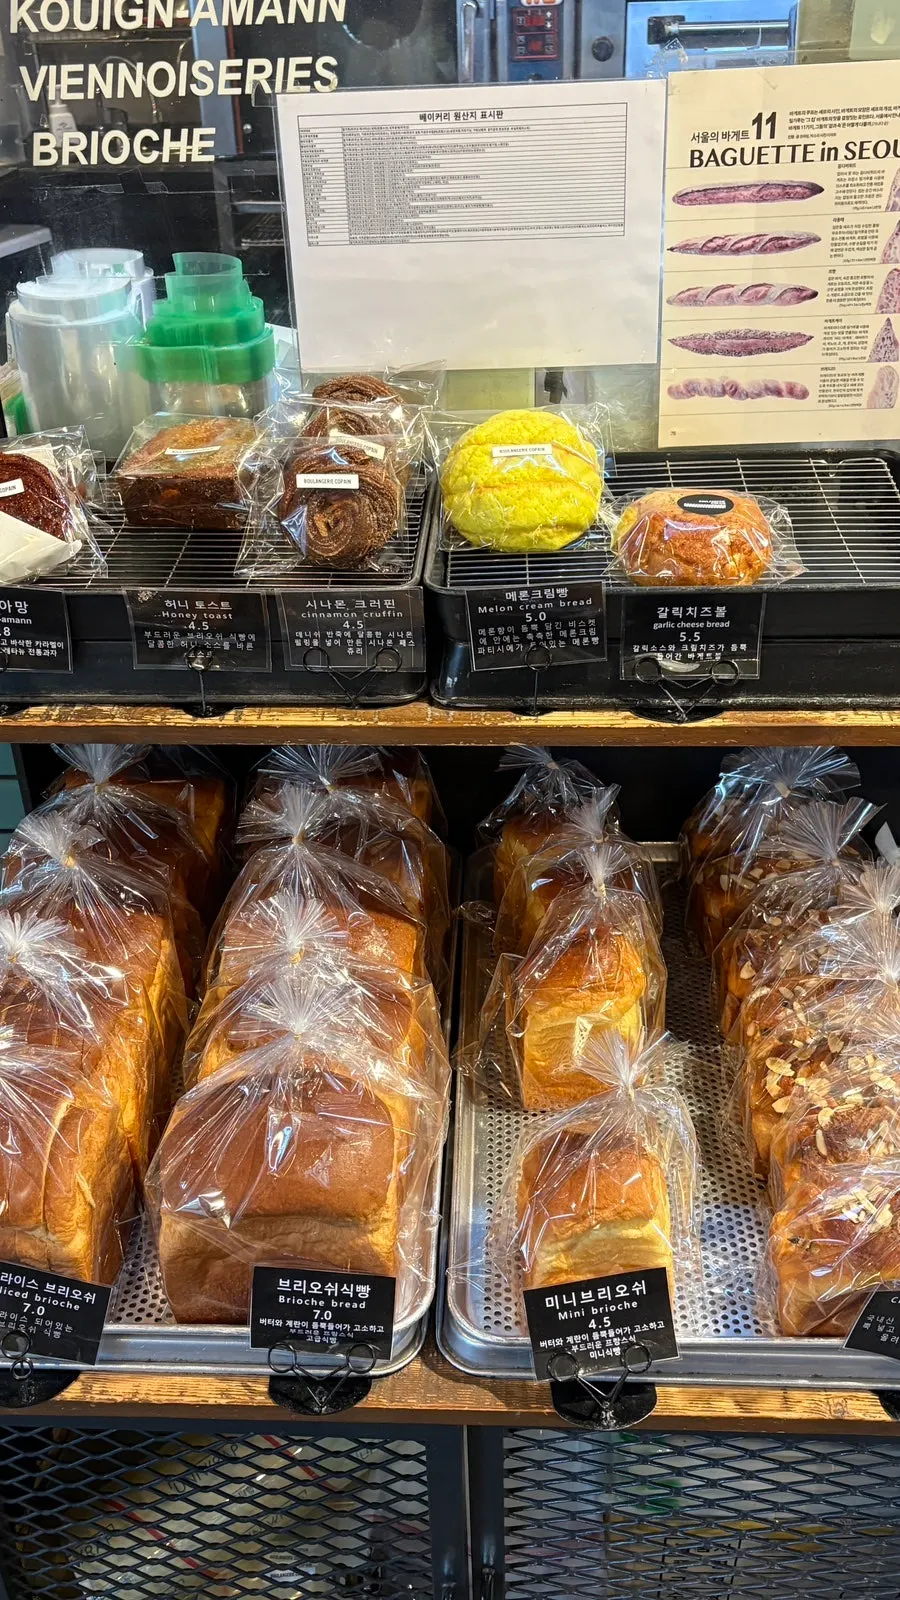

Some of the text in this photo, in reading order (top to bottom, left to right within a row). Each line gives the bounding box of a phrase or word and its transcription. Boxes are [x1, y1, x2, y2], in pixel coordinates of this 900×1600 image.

[9, 0, 347, 33] KOUIGN-AMANN
[19, 56, 339, 102] VIENNOISERIES
[419, 110, 504, 122] 베이커리 원산지 표시판
[751, 111, 777, 140] 11
[690, 129, 750, 144] 서울의 바게트
[32, 127, 216, 167] BRIOCHE
[689, 143, 816, 168] BAGUETTE
[820, 141, 839, 162] in
[505, 587, 568, 602] 메론크림빵
[0, 599, 29, 614] 아망
[164, 599, 232, 610] 허니 토스트
[305, 598, 395, 610] 시나몬 크러핀
[477, 597, 592, 614] Melon cream bread
[161, 611, 233, 620] Honey toast
[301, 610, 403, 619] cinnamon cruffin
[525, 611, 547, 623] 5.0
[656, 605, 727, 619] 갈릭치즈볼
[188, 621, 210, 631] 4.5
[342, 620, 364, 629] 4.5
[478, 625, 515, 636] 메론향이
[544, 621, 562, 631] 담긴
[568, 618, 597, 628] 비스켓
[652, 620, 730, 630] garlic cheese bread
[143, 631, 181, 640] 부드러운
[228, 633, 256, 642] 식빵에
[295, 631, 413, 639] 데니쉬 반죽에 달콤한 시나몬
[493, 634, 520, 644] 안에는
[526, 631, 553, 641] 촉촉한
[559, 627, 597, 638] 메론크림
[679, 631, 701, 642] 5.5
[10, 639, 33, 648] 바삭한
[34, 640, 64, 650] 카라멜이
[204, 641, 231, 650] 소스를
[236, 641, 255, 651] 바른
[325, 639, 342, 647] 넣어
[346, 639, 363, 647] 만든
[368, 639, 394, 647] 시나몬
[477, 643, 524, 655] 파티시에가
[572, 636, 600, 647] 메론빵
[632, 643, 748, 653] 갈릭소스와 크림치즈가 듬뿍
[28, 648, 57, 658] 전통과자
[0, 1272, 96, 1305] 라이스 브리오쉬
[276, 1278, 371, 1299] 브리오쉬식빵
[544, 1279, 647, 1310] 미니브리오쉬
[22, 1302, 46, 1316] 7.0
[34, 1293, 80, 1311] brioche
[278, 1295, 367, 1309] Brioche bread
[312, 1309, 333, 1321] 7.0
[557, 1300, 638, 1321] Mini brioche
[34, 1317, 74, 1333] 되어있는
[259, 1317, 385, 1333] 버터와 계란이 듬뿍들어가 고소하고
[588, 1316, 612, 1330] 4.5
[866, 1314, 895, 1325] 국내산
[43, 1328, 62, 1339] 식빵
[305, 1335, 338, 1344] 고급식빵
[539, 1320, 665, 1349] 버터와 계란이 듬뿍들어가 고소하고
[571, 1334, 637, 1353] 부드러운 프랑스식
[589, 1347, 622, 1360] 미니식빵
